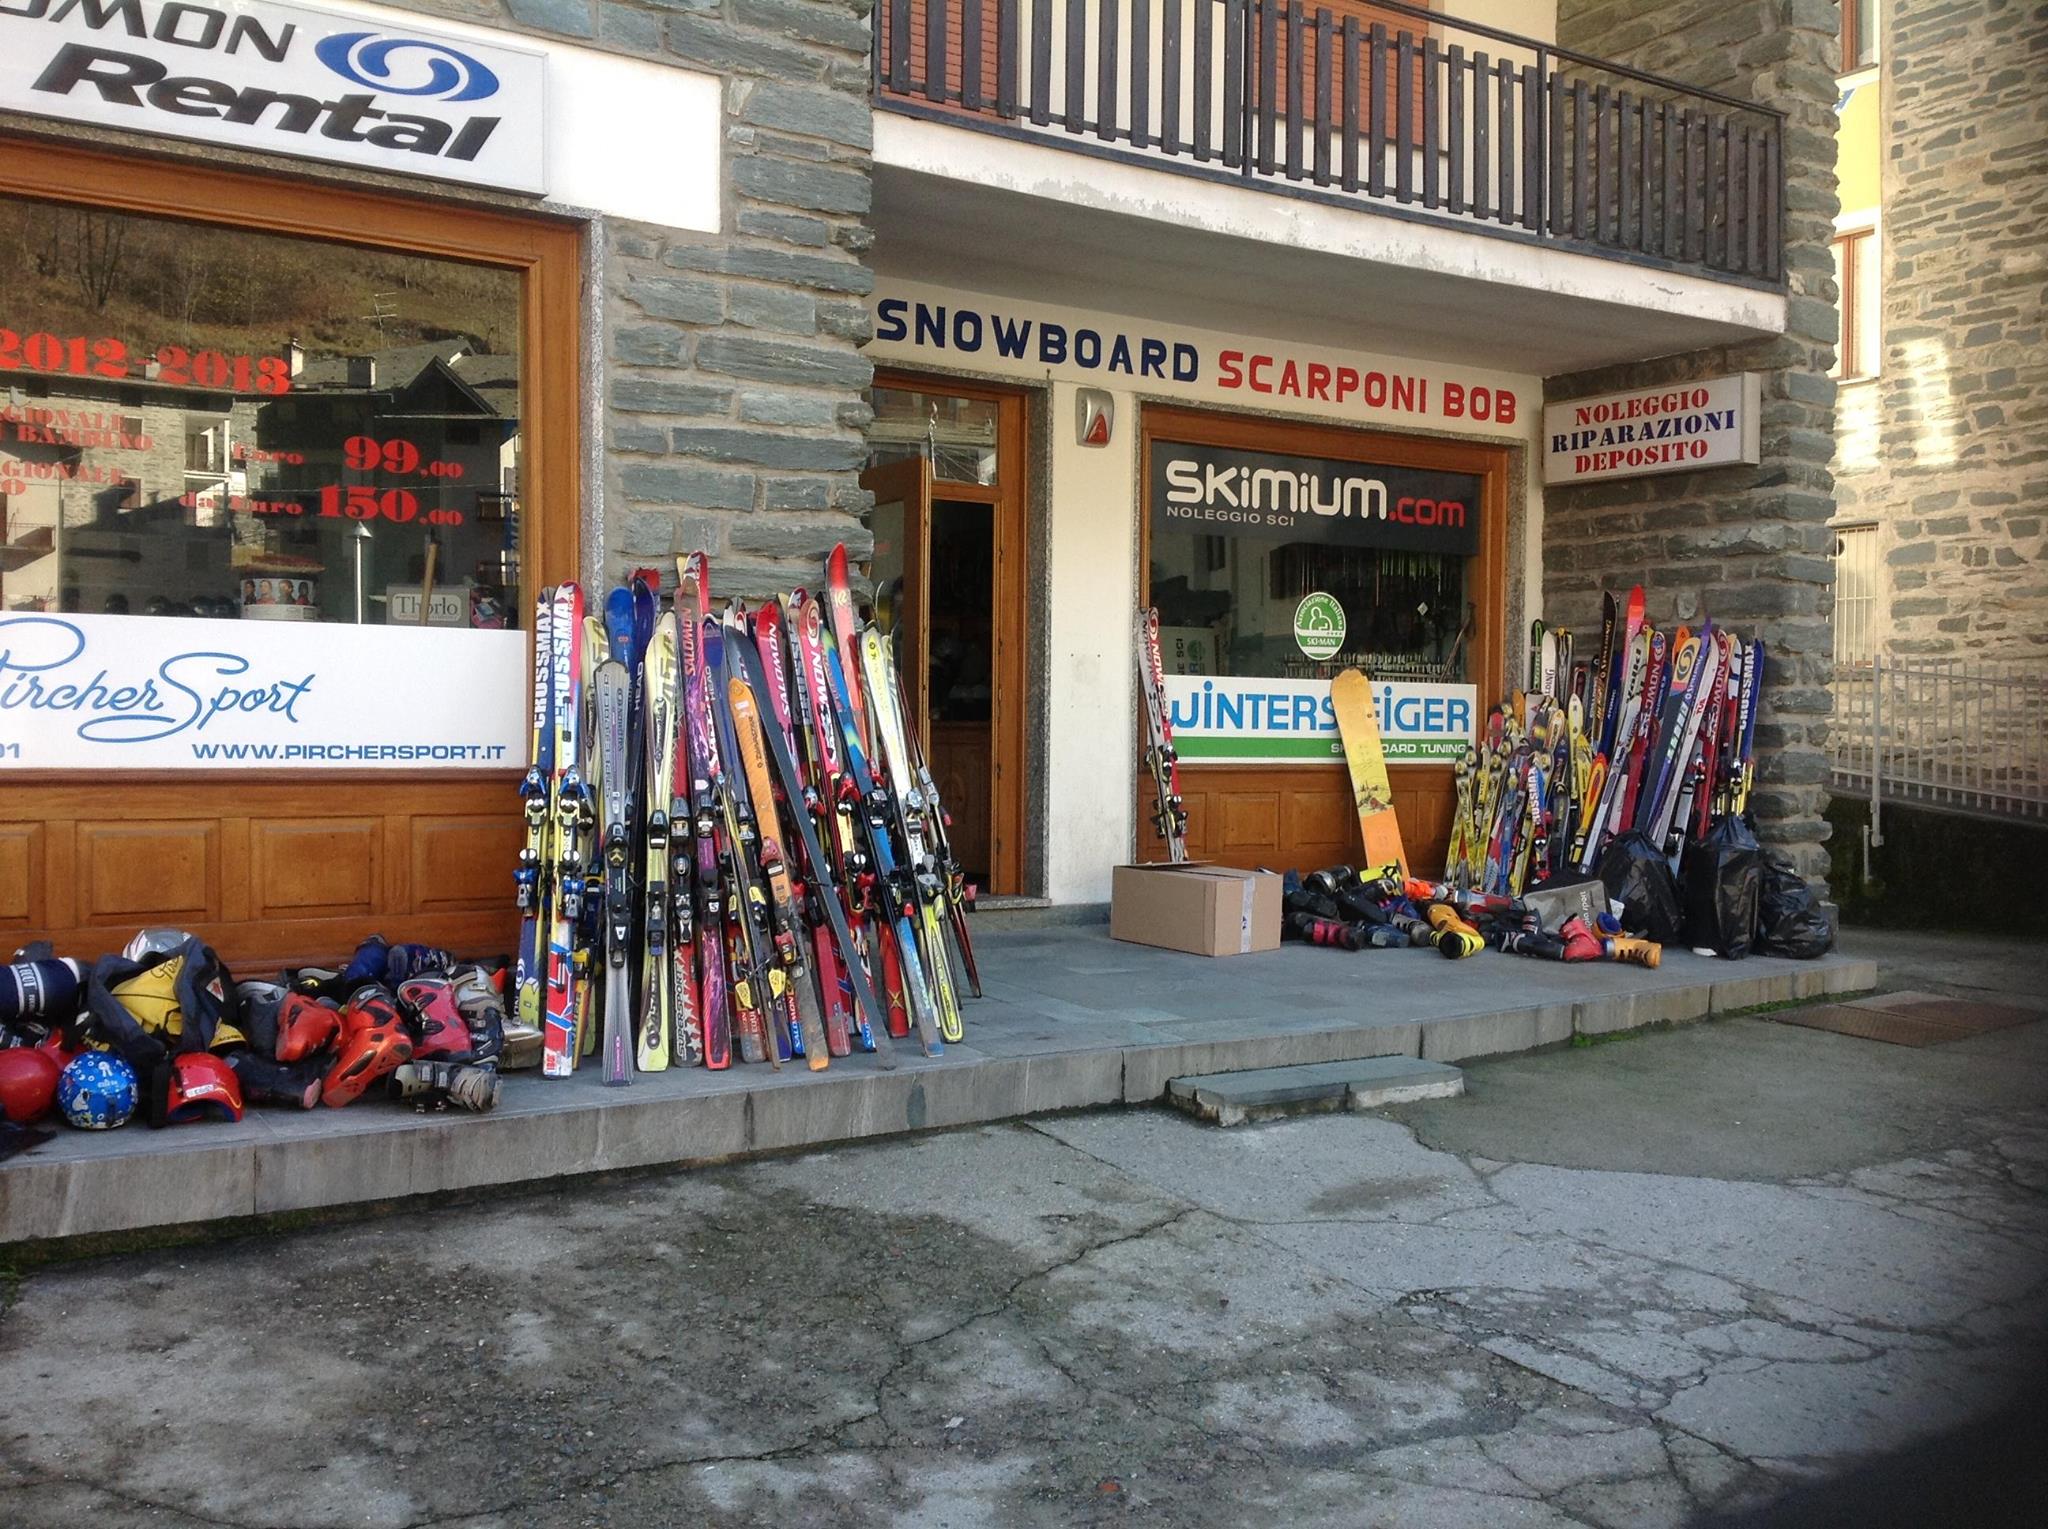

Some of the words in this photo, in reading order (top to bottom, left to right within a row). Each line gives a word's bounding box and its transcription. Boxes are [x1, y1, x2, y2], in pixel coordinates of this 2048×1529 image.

[30, 42, 501, 162] Rental
[877, 299, 1200, 382] SNOWBOARD
[1217, 351, 1428, 416] SCARPONI
[1443, 388, 1517, 425] BOB
[1551, 409, 1736, 454] RIPARAZIONI
[1575, 388, 1709, 427] NOLEGGIO
[1574, 439, 1709, 474] DEPOSITO
[1166, 506, 1262, 526] NOLEGGIO
[1267, 514, 1295, 528] SCI
[0, 617, 163, 711] Pircher
[533, 601, 551, 729] CROSSMAX
[681, 607, 697, 676] SALOMON
[768, 621, 791, 719] SALOMON
[78, 651, 316, 743] Sport
[634, 661, 644, 712] HEAD
[1168, 680, 1470, 732] WINTERSIGER
[1740, 644, 1755, 731] CROSSMAX
[191, 743, 507, 761] WWW.PIRCHERSPORT.IT
[1420, 743, 1466, 754] TUNING
[675, 964, 688, 1060] SUPERSPORT
